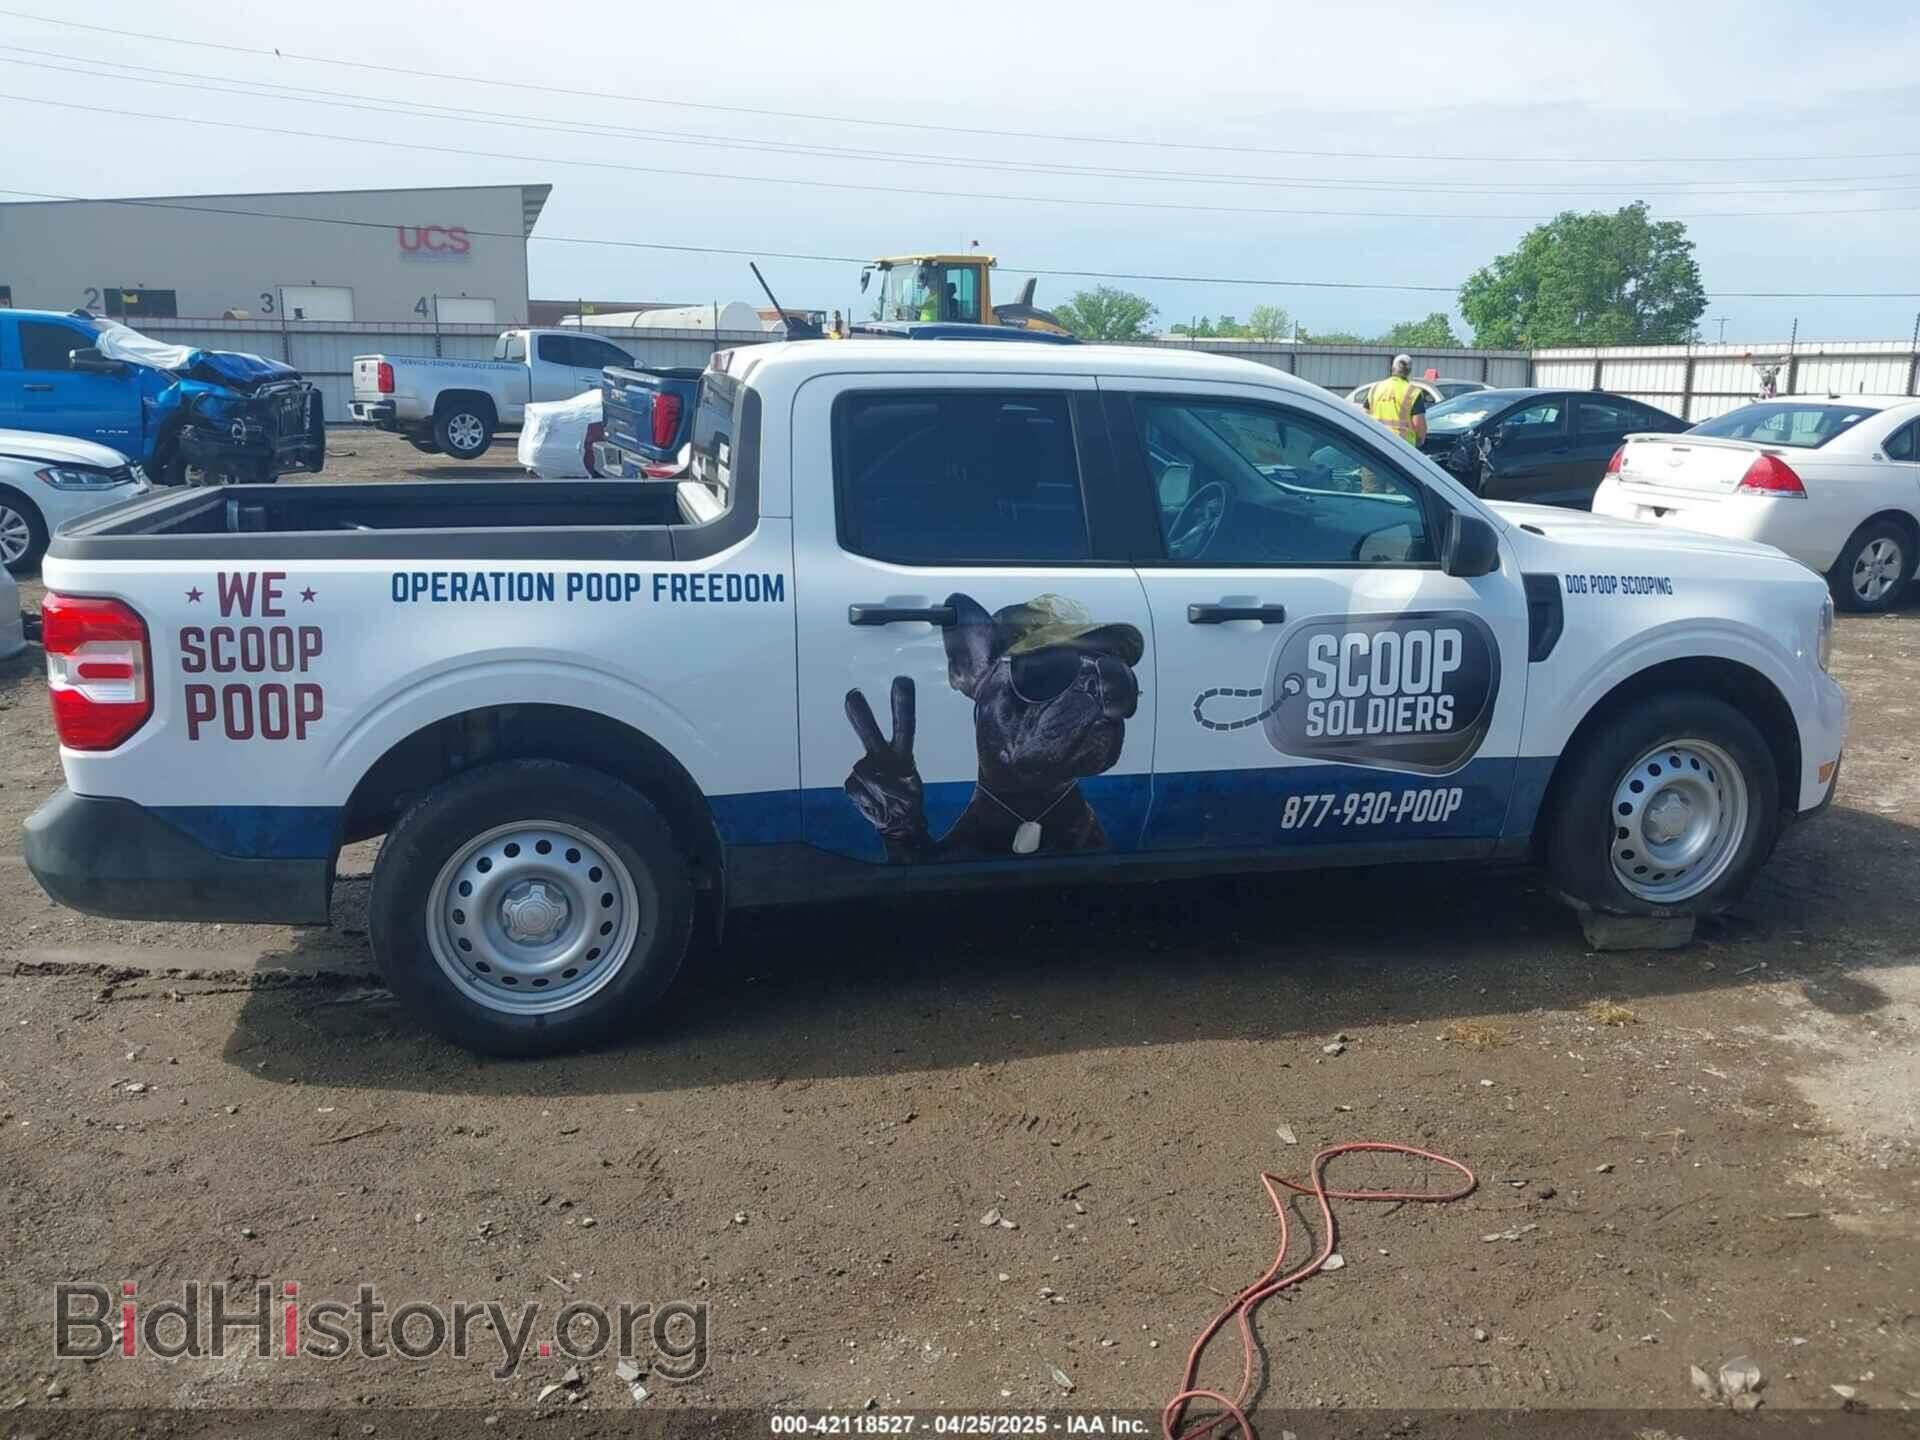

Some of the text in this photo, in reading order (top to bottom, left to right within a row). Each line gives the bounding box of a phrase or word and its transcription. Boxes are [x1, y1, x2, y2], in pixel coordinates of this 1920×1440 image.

[397, 225, 470, 251] UCS
[83, 287, 100, 309] 2
[260, 293, 274, 313] 3
[414, 296, 429, 318] 4
[217, 572, 287, 617] WE
[391, 572, 784, 603] OPERATION POOP FREEDOM
[1565, 574, 1673, 595] DOG POOP SCOOPING
[180, 626, 323, 673] SCOOP
[1306, 629, 1463, 699] SCOOP
[185, 683, 324, 740] POOP
[1305, 695, 1455, 737] SOLDIERS
[1281, 787, 1463, 829] 877-930-POOP
